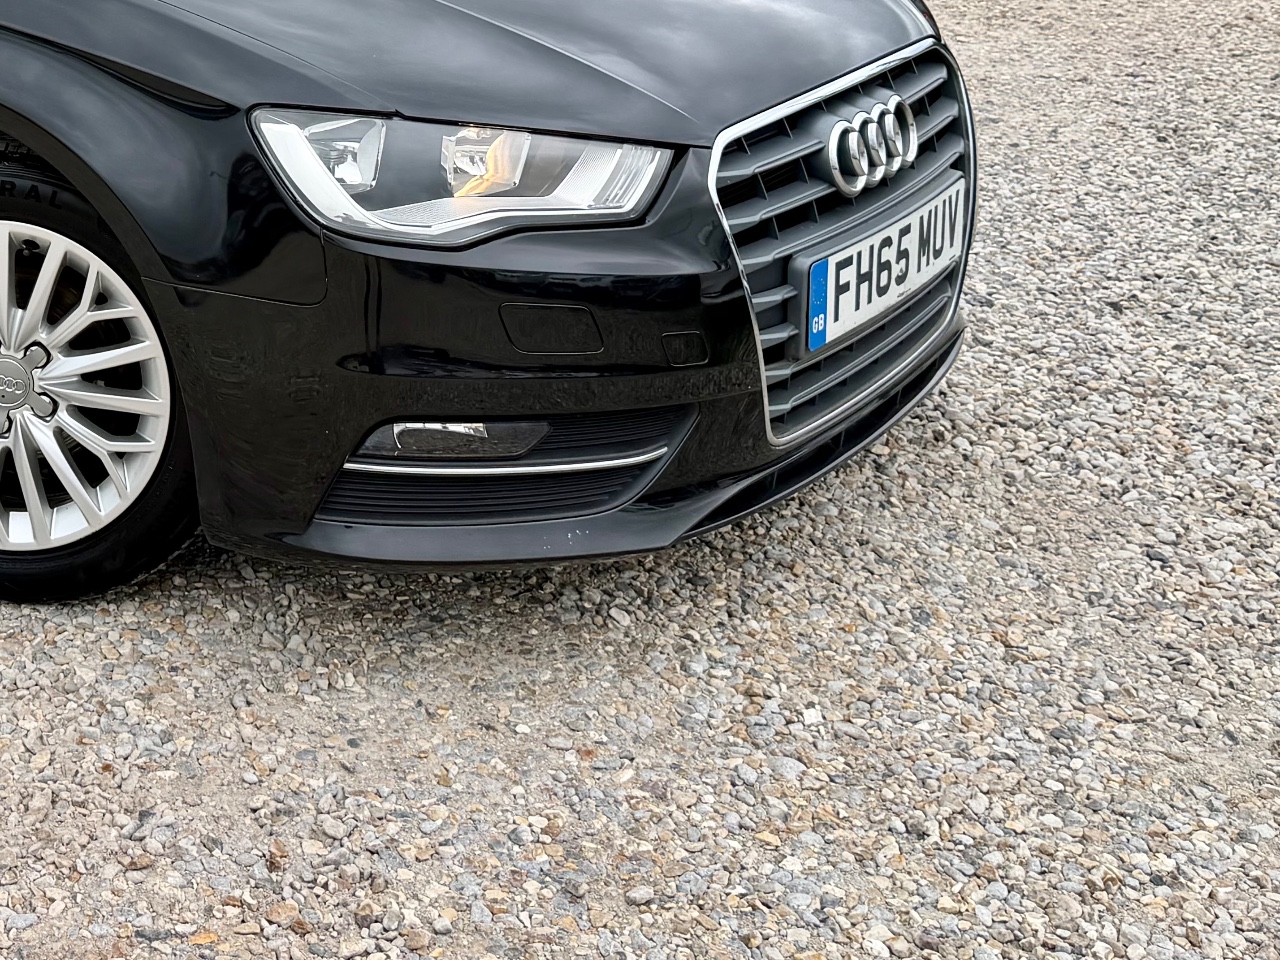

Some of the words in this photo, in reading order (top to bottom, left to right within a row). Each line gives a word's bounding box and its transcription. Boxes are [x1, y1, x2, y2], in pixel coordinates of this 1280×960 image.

[833, 222, 912, 323] FH65
[916, 188, 960, 273] MUV
[812, 313, 825, 334] GB
